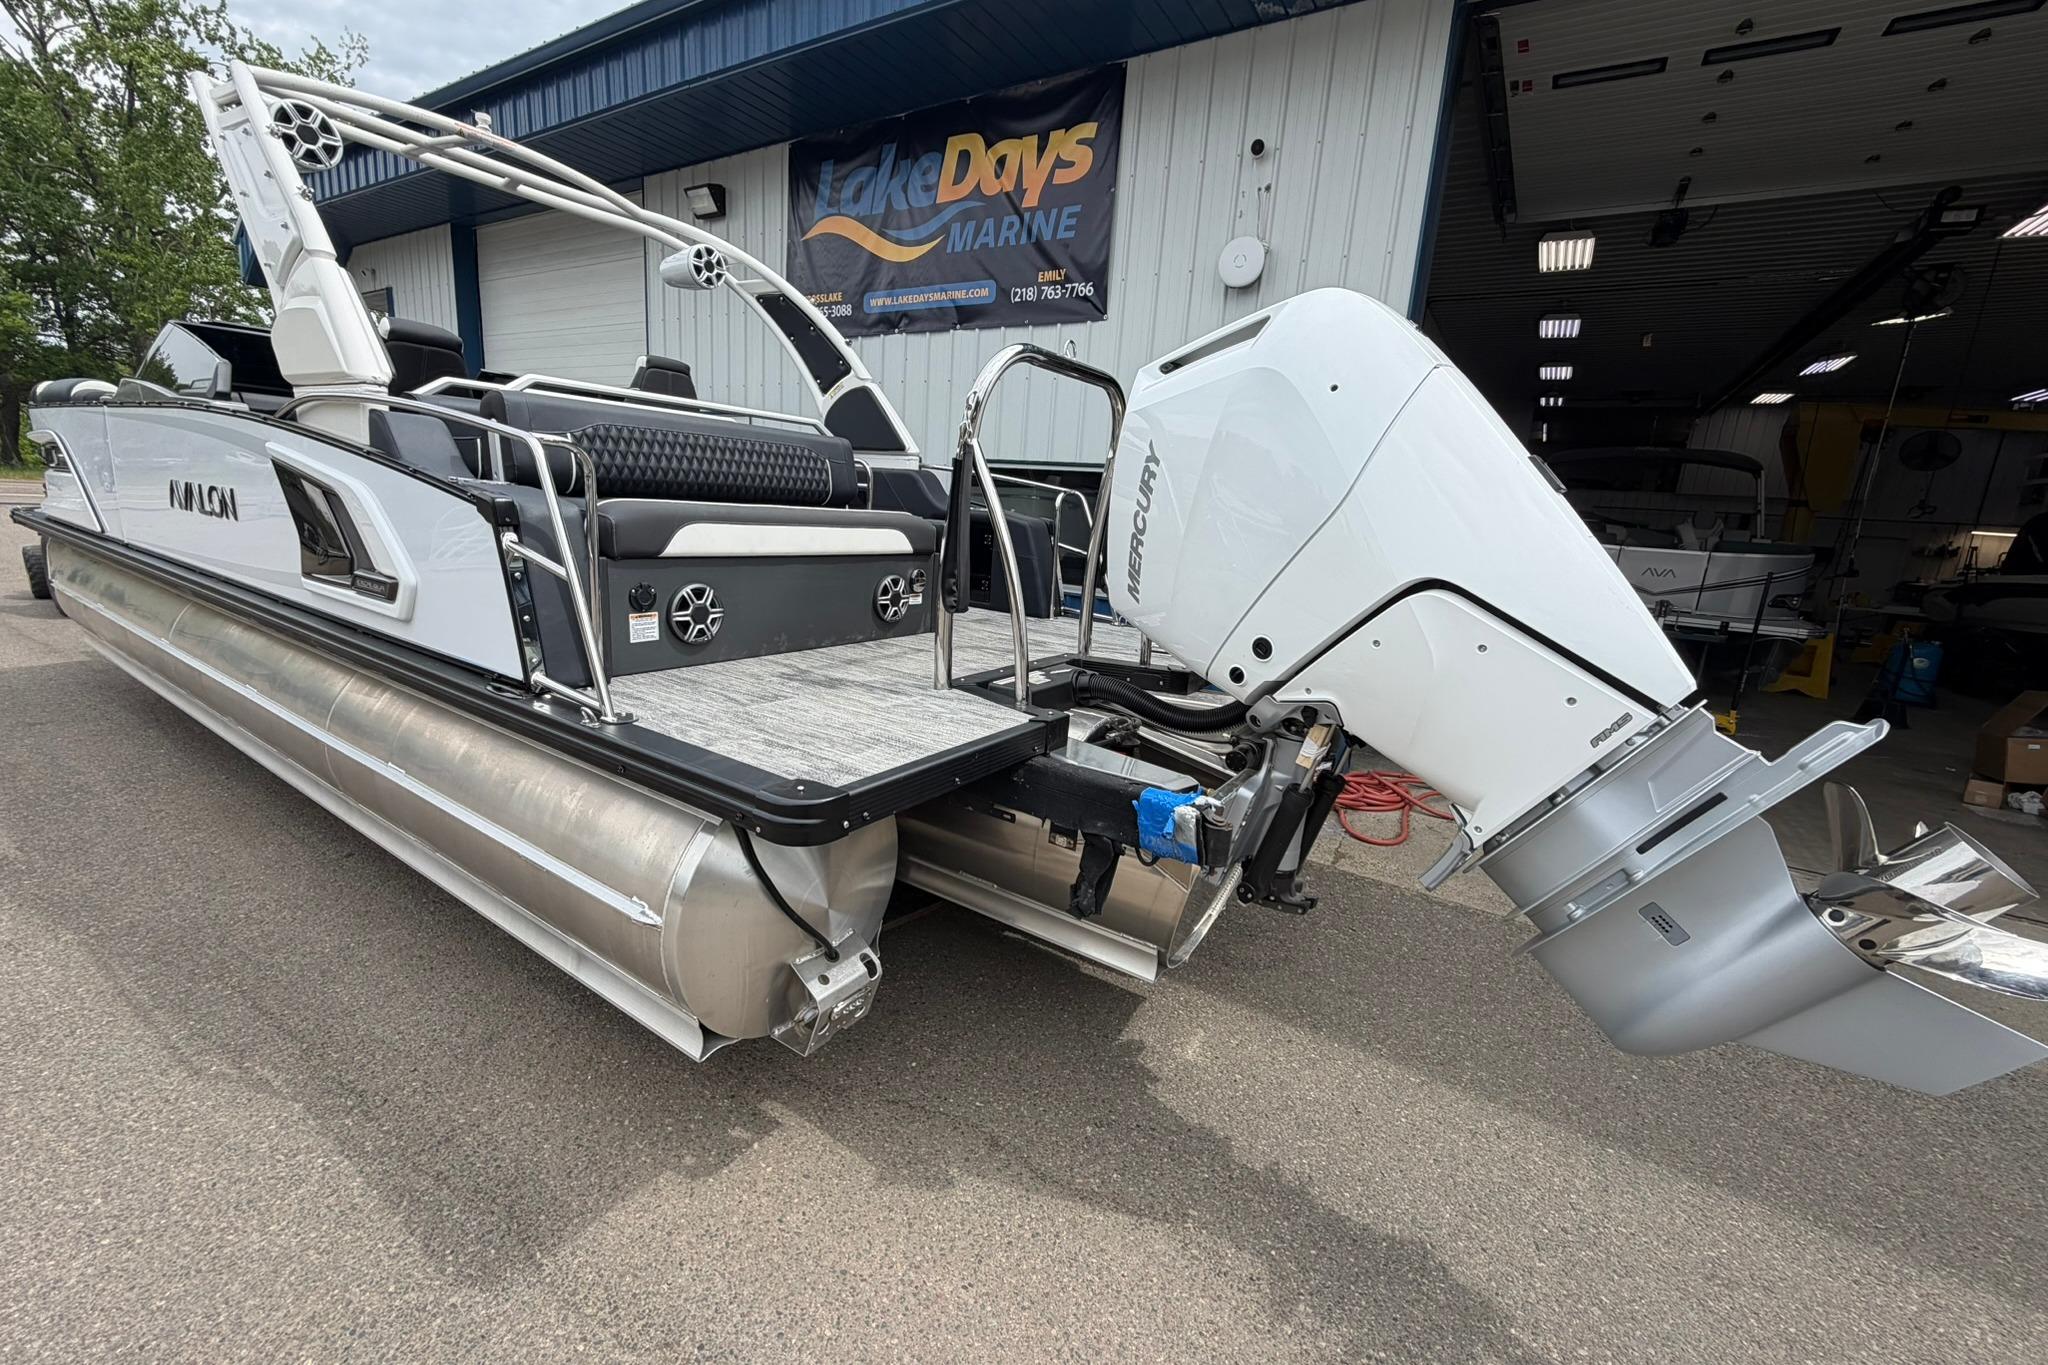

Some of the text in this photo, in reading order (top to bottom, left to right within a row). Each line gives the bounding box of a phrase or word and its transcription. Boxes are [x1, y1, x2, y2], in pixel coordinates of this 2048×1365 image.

[946, 204, 1082, 253] MARINE
[1038, 268, 1067, 282] EMILY
[869, 286, 989, 307] WWW.LAKEDAYSMARINE.COM
[1010, 281, 1095, 304] (218) 763-7766
[169, 479, 239, 522] AVALON
[1127, 438, 1161, 604] MERCURY
[1640, 567, 1676, 578] AVA
[1590, 711, 1633, 748] AMS
